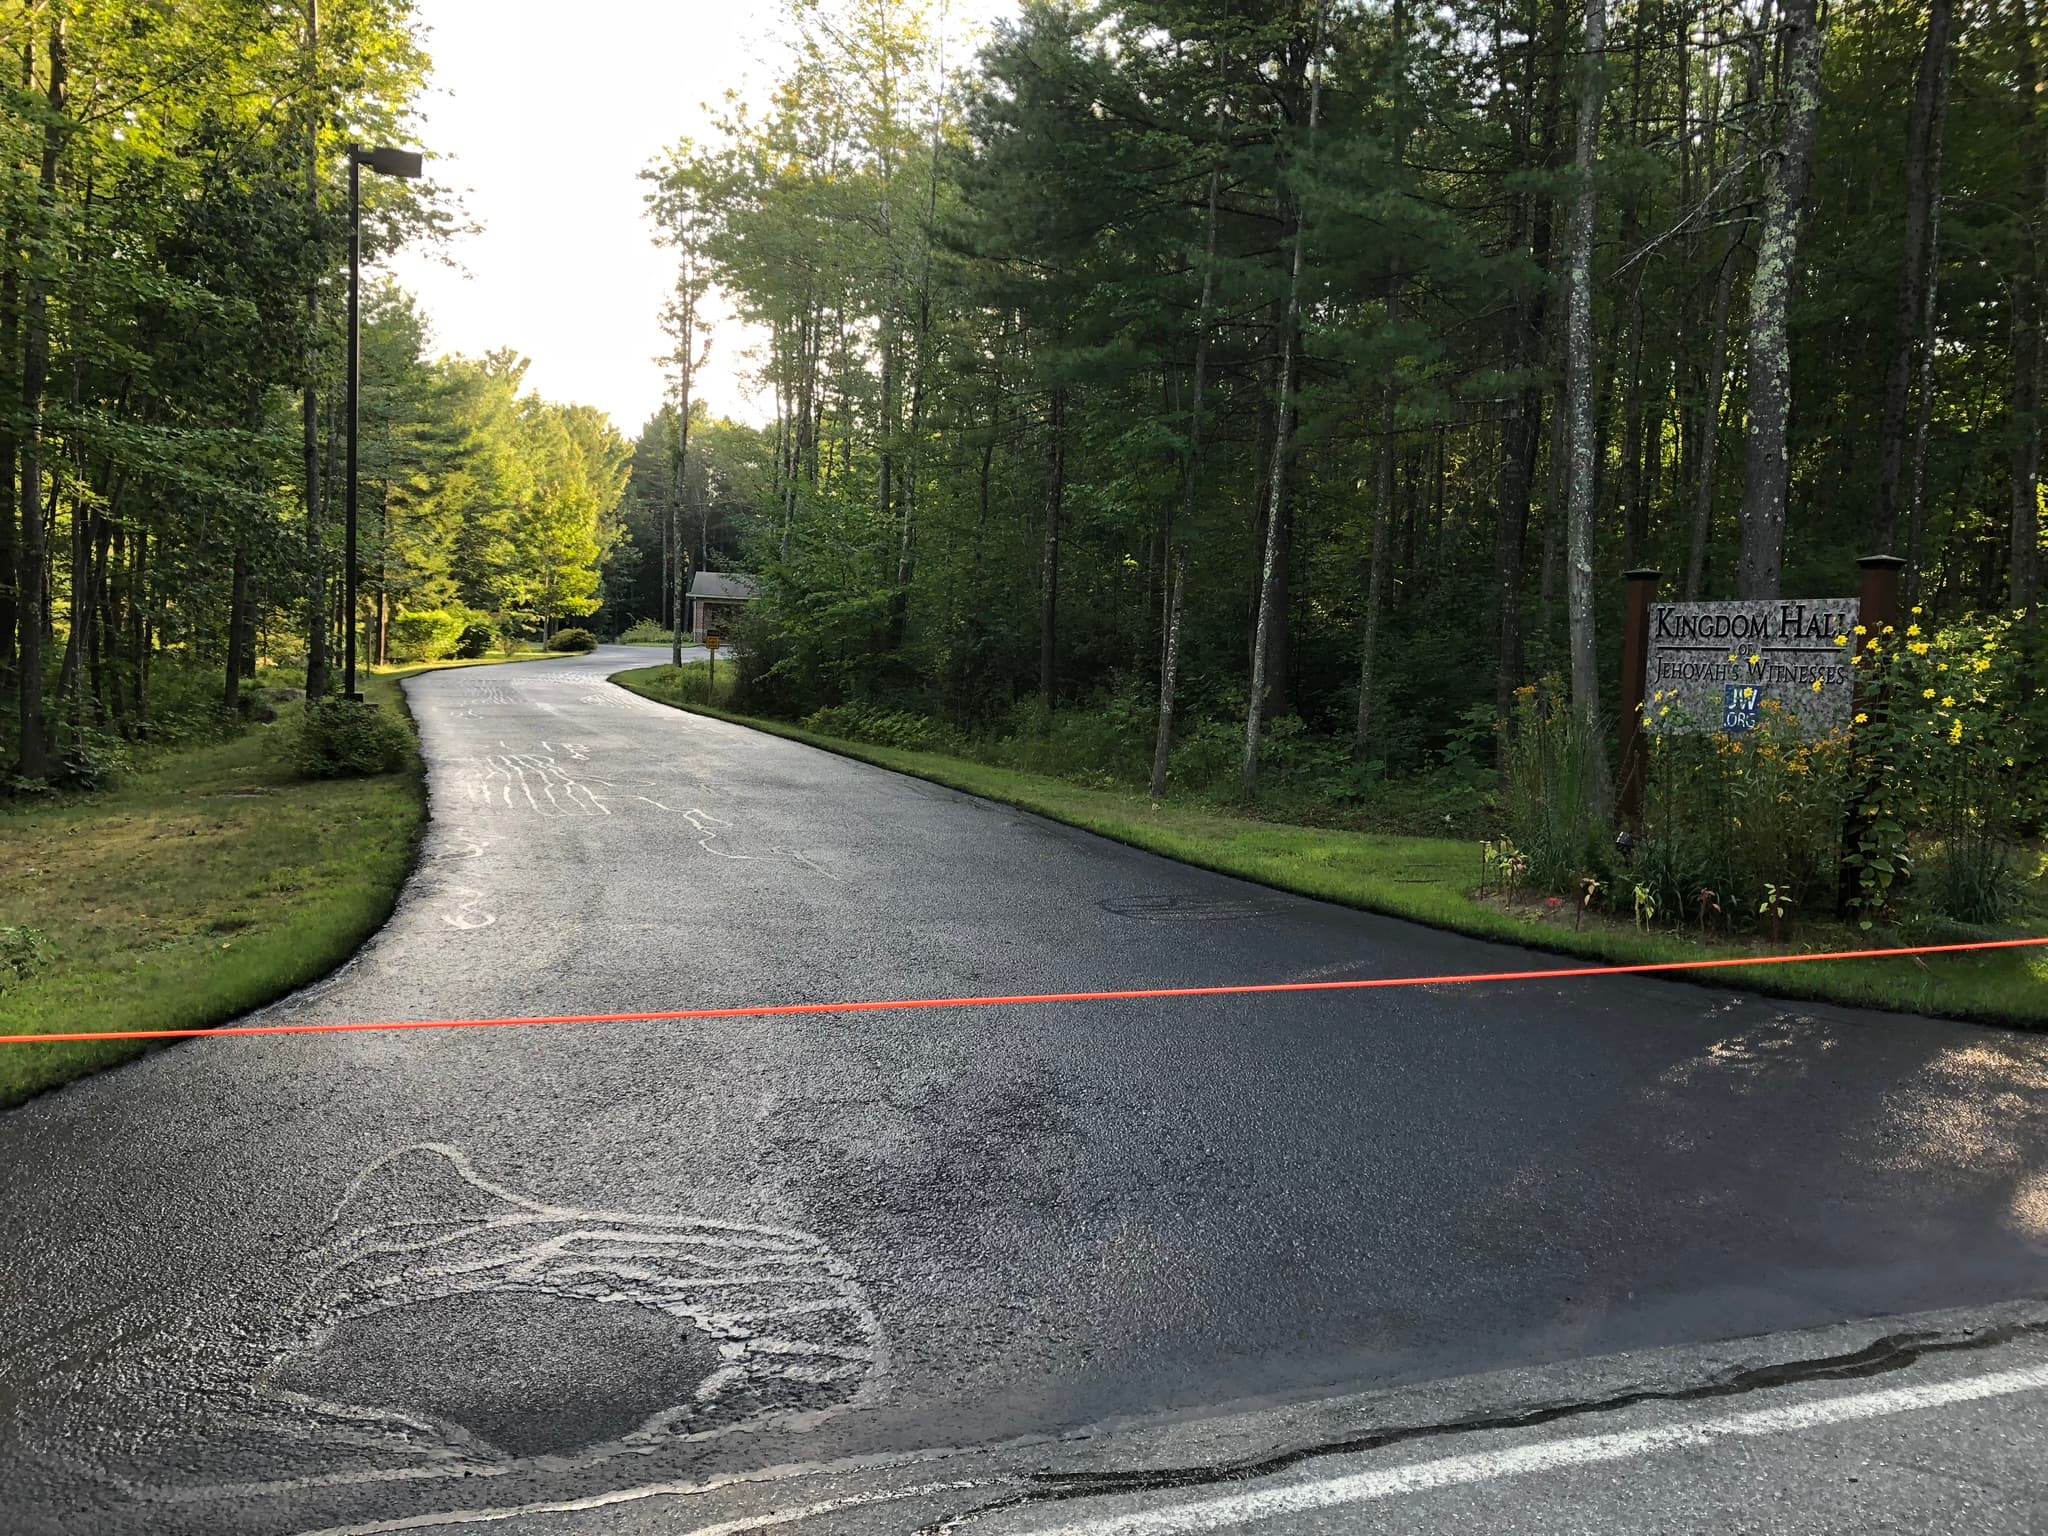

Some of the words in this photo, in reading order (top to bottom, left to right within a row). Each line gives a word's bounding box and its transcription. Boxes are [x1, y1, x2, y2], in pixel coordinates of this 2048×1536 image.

[1655, 607, 1769, 639] KINGDOM
[1779, 604, 1852, 639] HALL
[1738, 645, 1753, 656] OF
[1746, 658, 1846, 685] WITNESSES
[1728, 689, 1757, 710] JW
